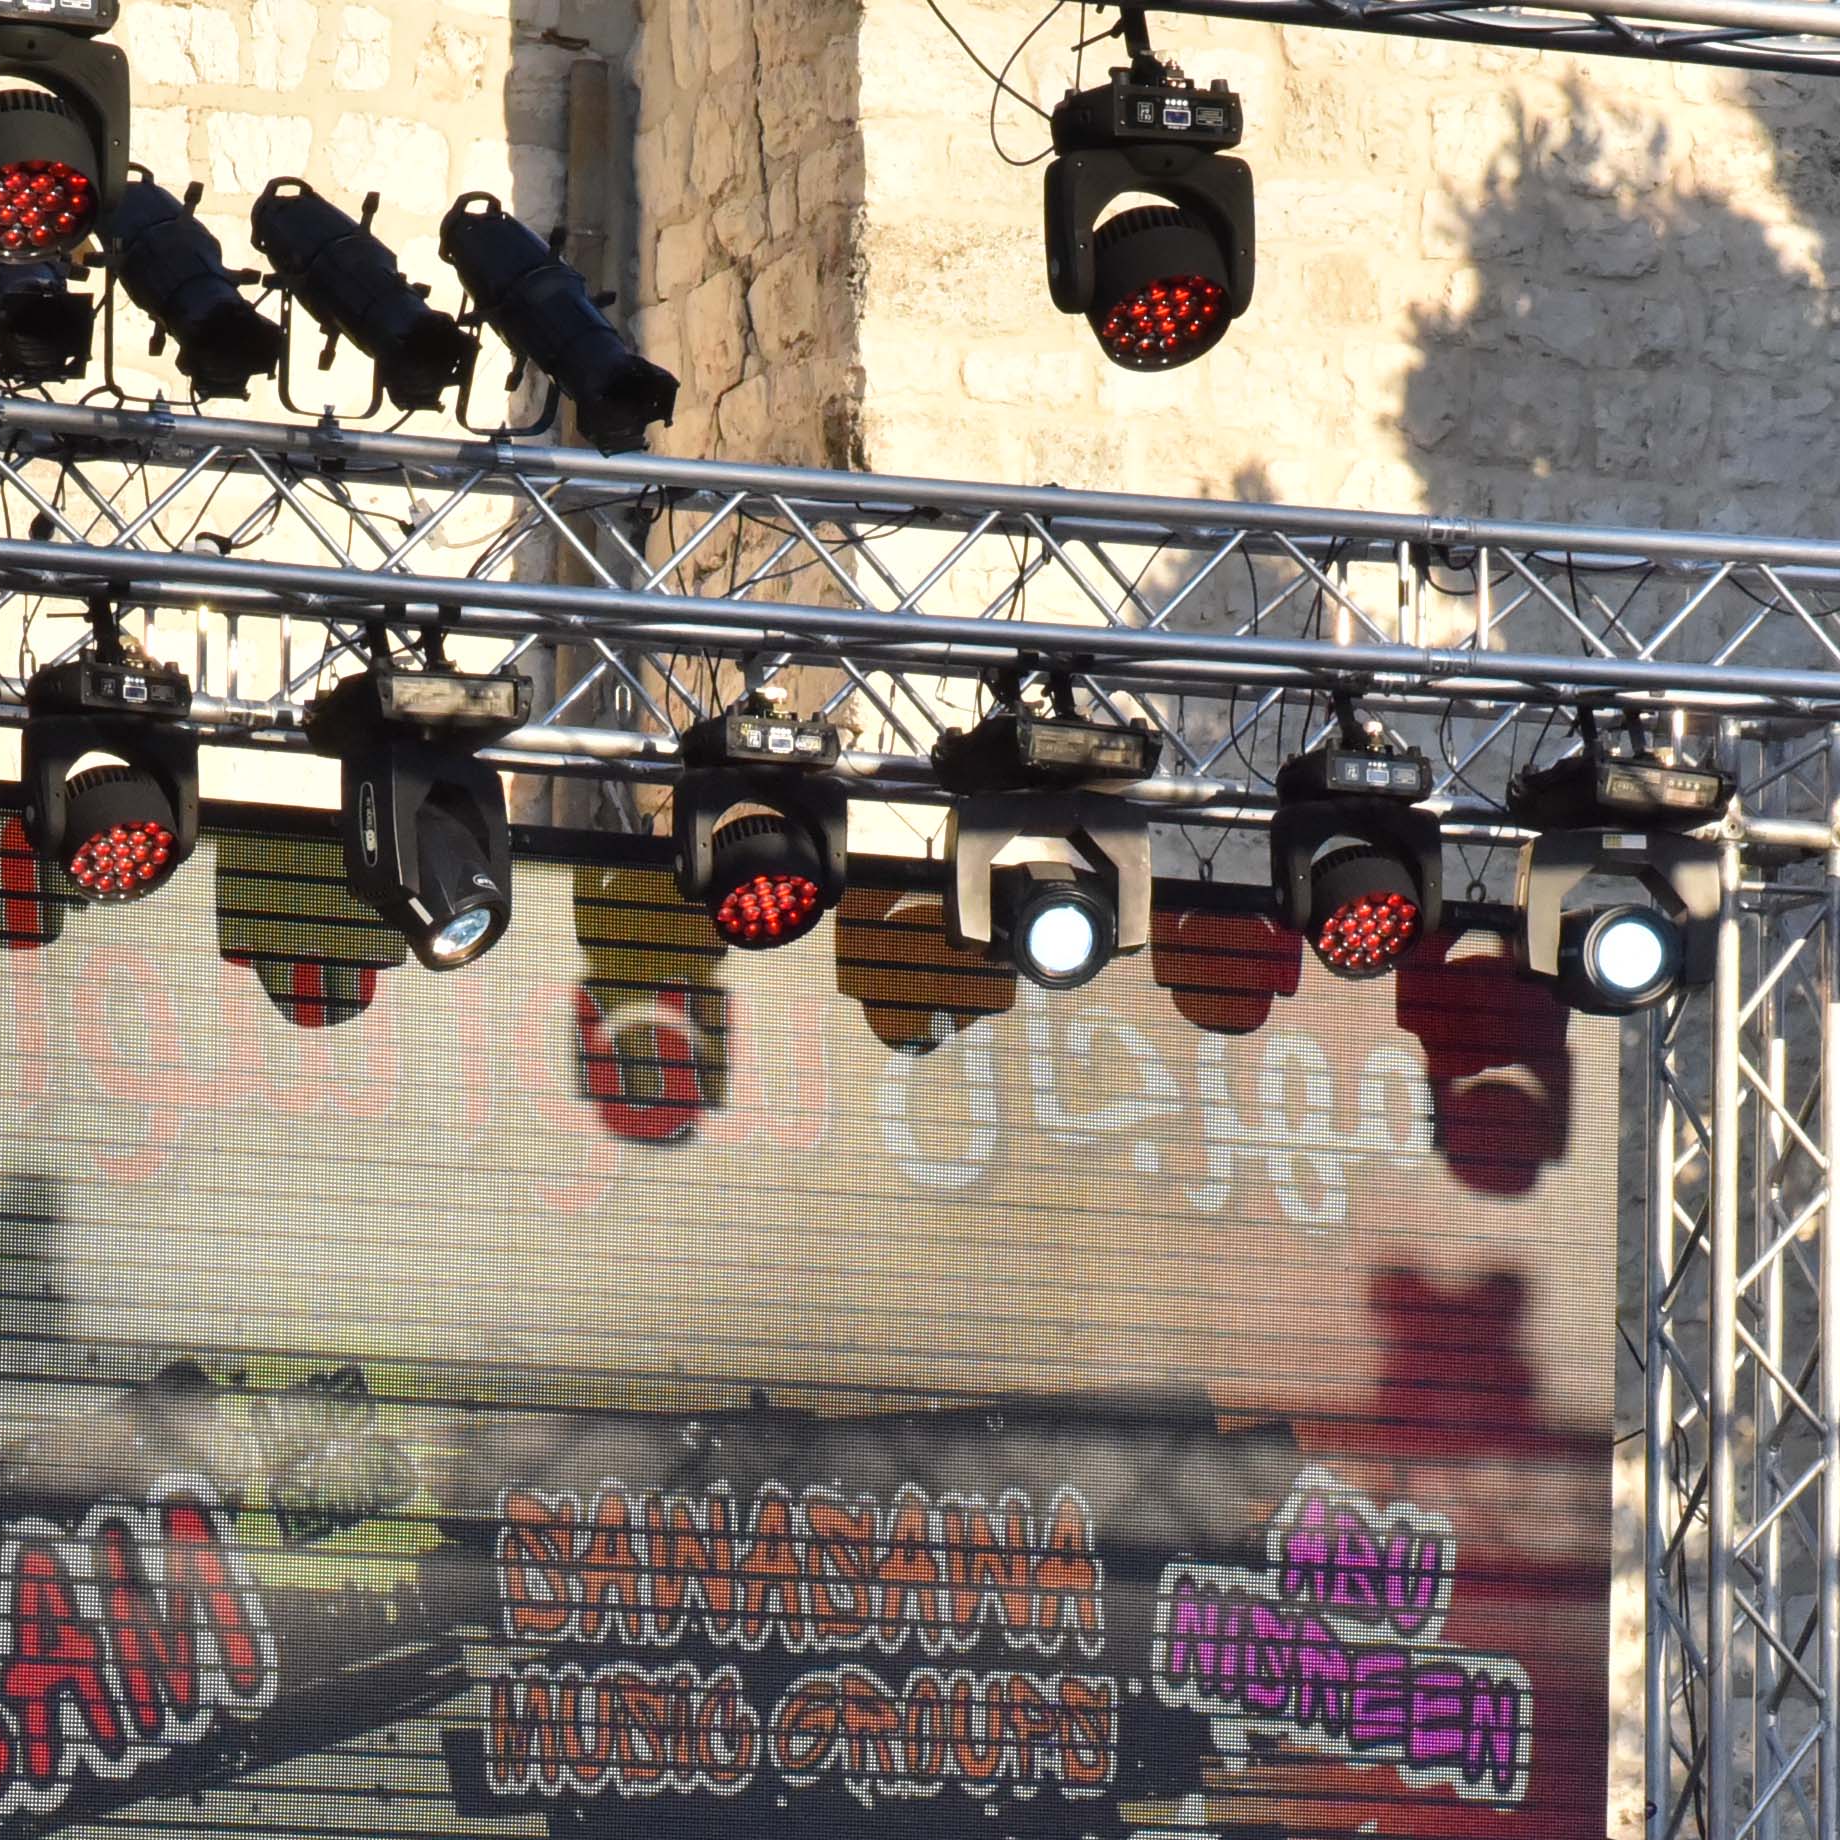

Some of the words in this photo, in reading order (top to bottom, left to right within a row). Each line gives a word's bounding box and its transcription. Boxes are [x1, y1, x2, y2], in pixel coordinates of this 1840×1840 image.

[1268, 1466, 1456, 1643] ABU
[485, 1662, 760, 1794] MUSIC
[768, 1666, 1117, 1802] GROUPS
[1154, 1561, 1532, 1802] NISREEN
